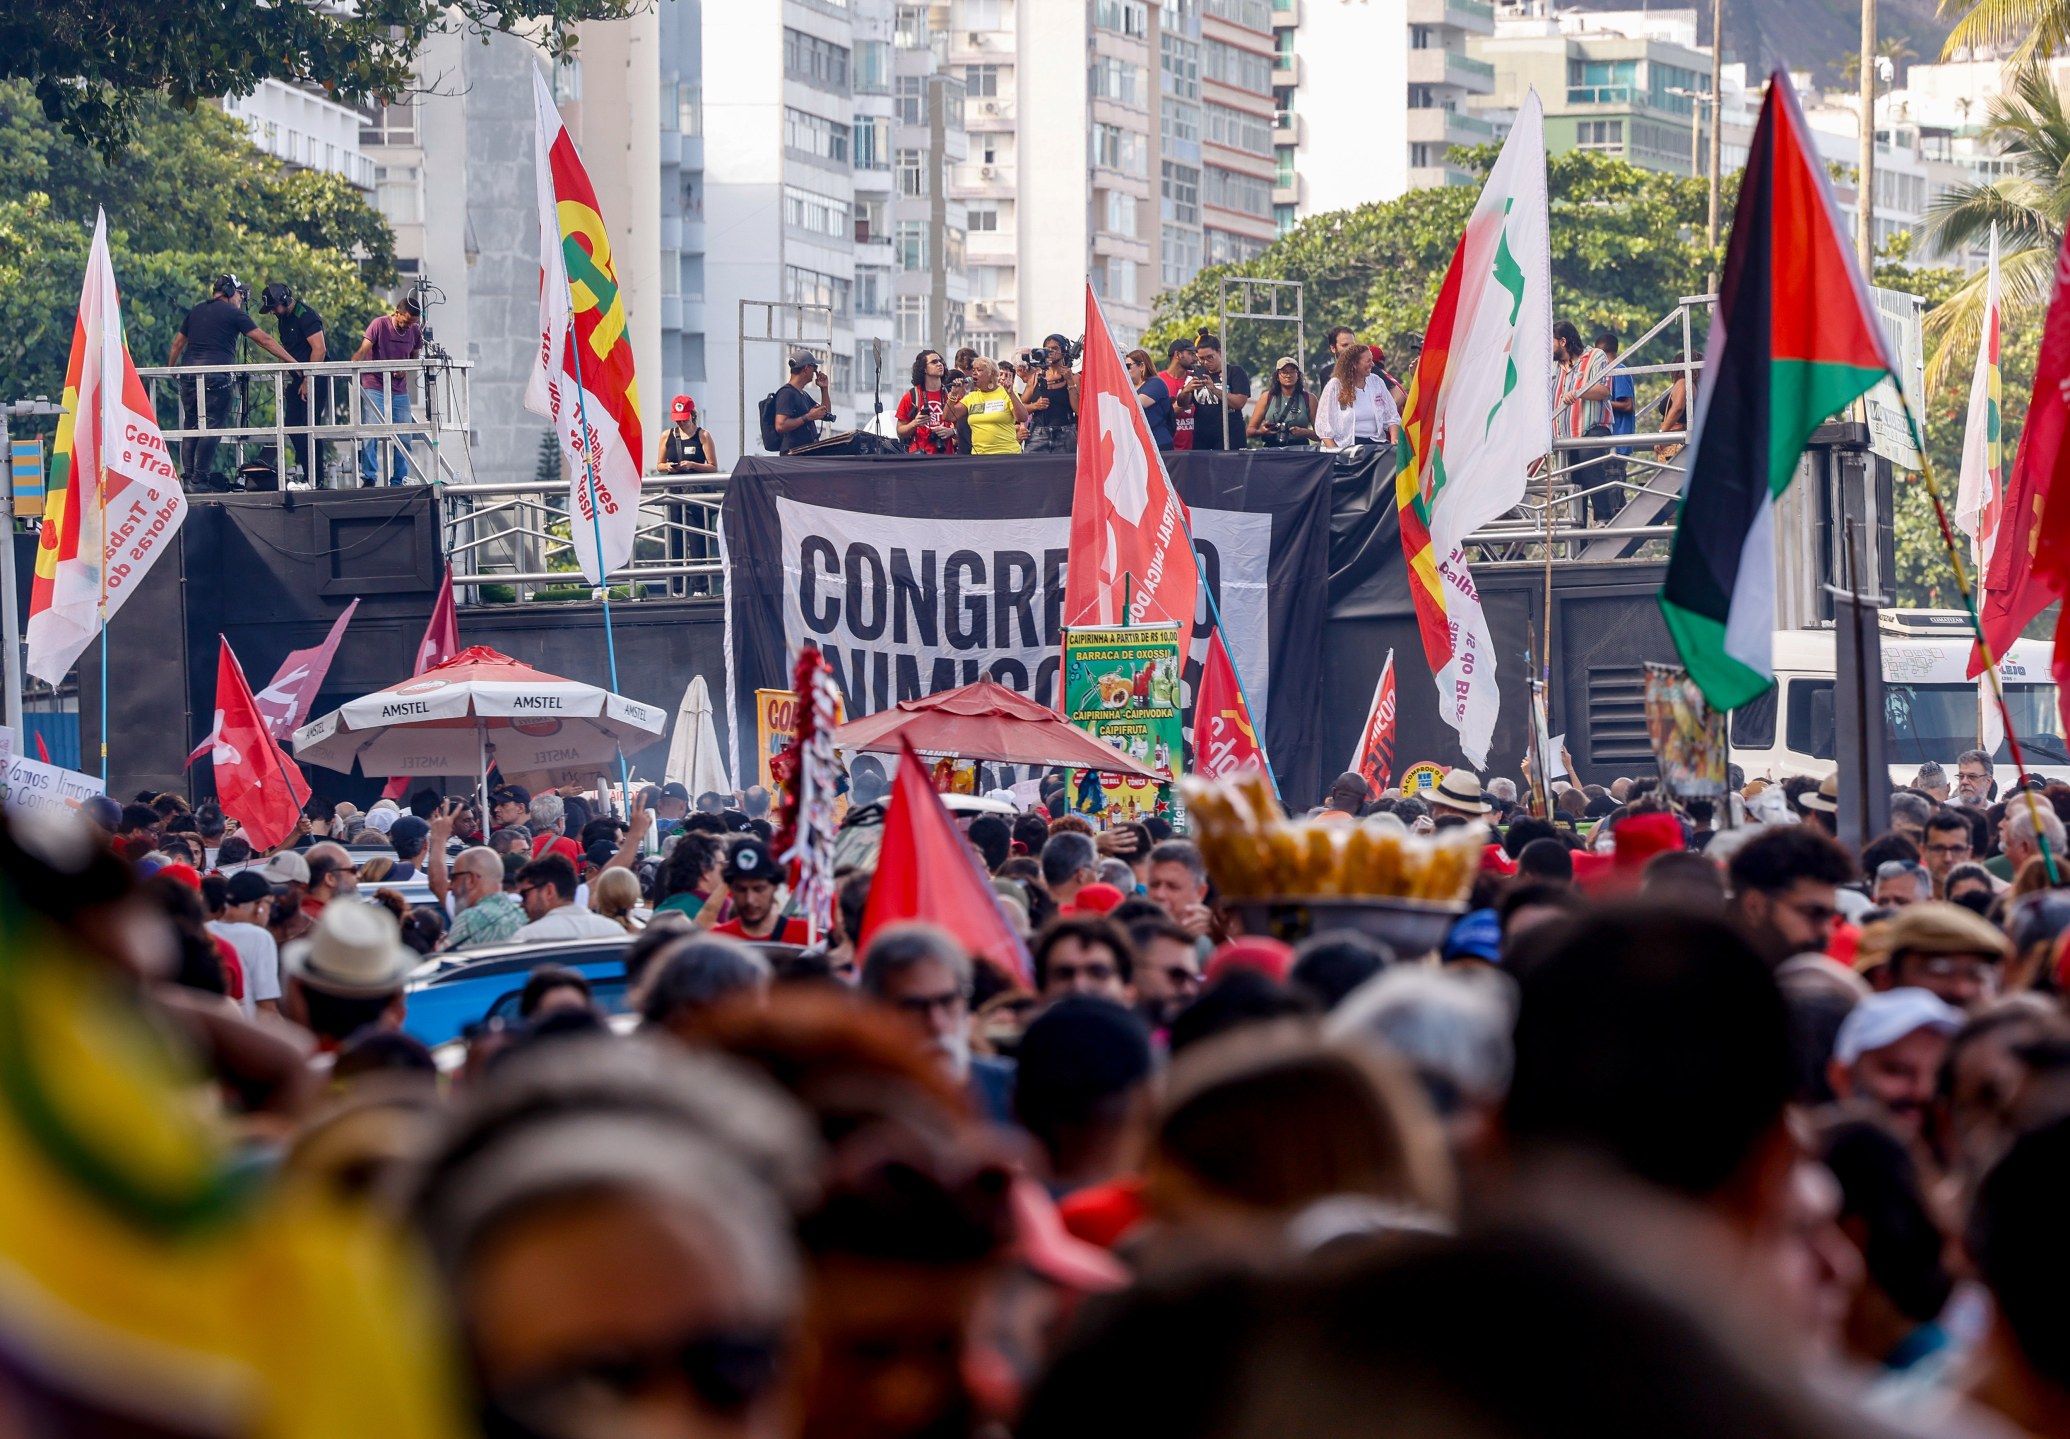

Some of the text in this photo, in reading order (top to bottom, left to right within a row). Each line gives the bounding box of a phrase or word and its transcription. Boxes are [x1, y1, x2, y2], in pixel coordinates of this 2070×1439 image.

[799, 534, 1222, 650] CONGREO
[1069, 631, 1178, 645] CAIPIRINHA A PARTIR DE R$ 10,00
[1076, 651, 1120, 661] BARRACA
[1121, 650, 1134, 660] DE
[382, 701, 430, 718] AMSTEL
[513, 696, 563, 709] AMSTEL
[624, 704, 647, 722] AMSTEL
[1073, 710, 1121, 721] CAIPIRINHA
[305, 723, 325, 741] AMSTEL
[1099, 725, 1148, 735] CAIPIFRUTA
